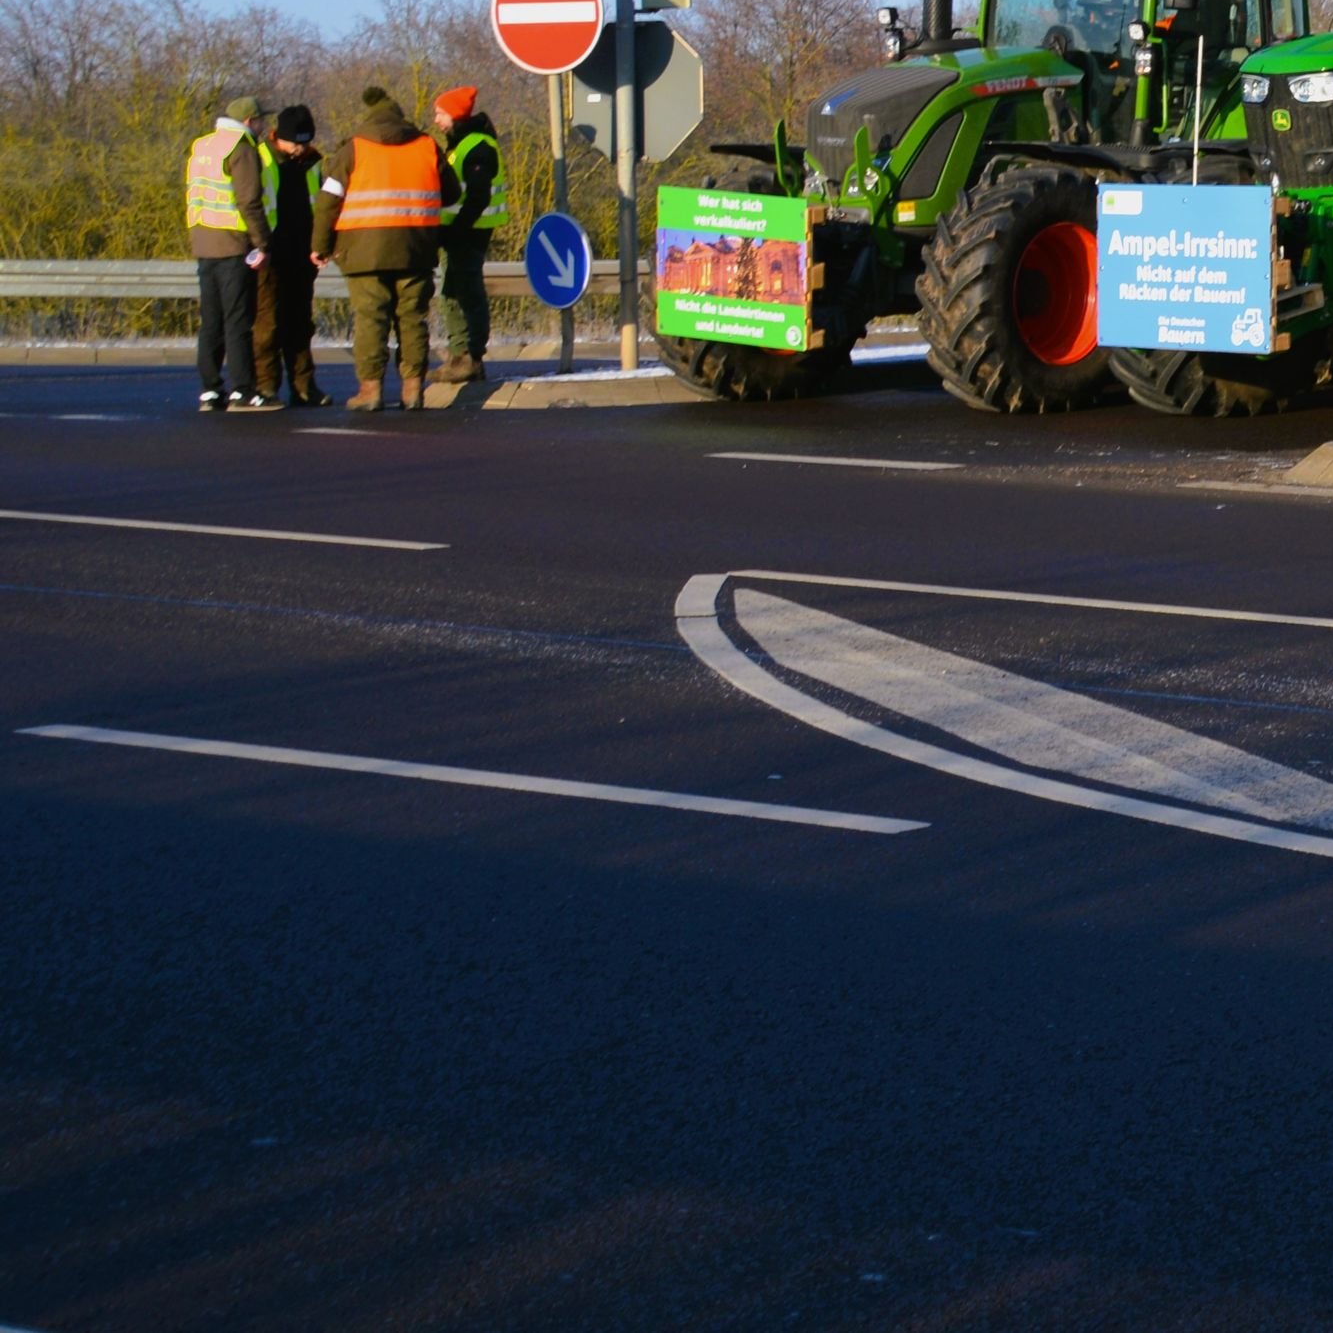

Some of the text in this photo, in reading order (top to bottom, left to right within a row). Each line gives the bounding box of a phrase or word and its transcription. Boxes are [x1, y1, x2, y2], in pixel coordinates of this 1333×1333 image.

[1107, 229, 1258, 262] Ampel-Irrsinn:
[1136, 265, 1228, 285] Nicht auf dem
[1119, 282, 1246, 304] Rücken der Bauern!
